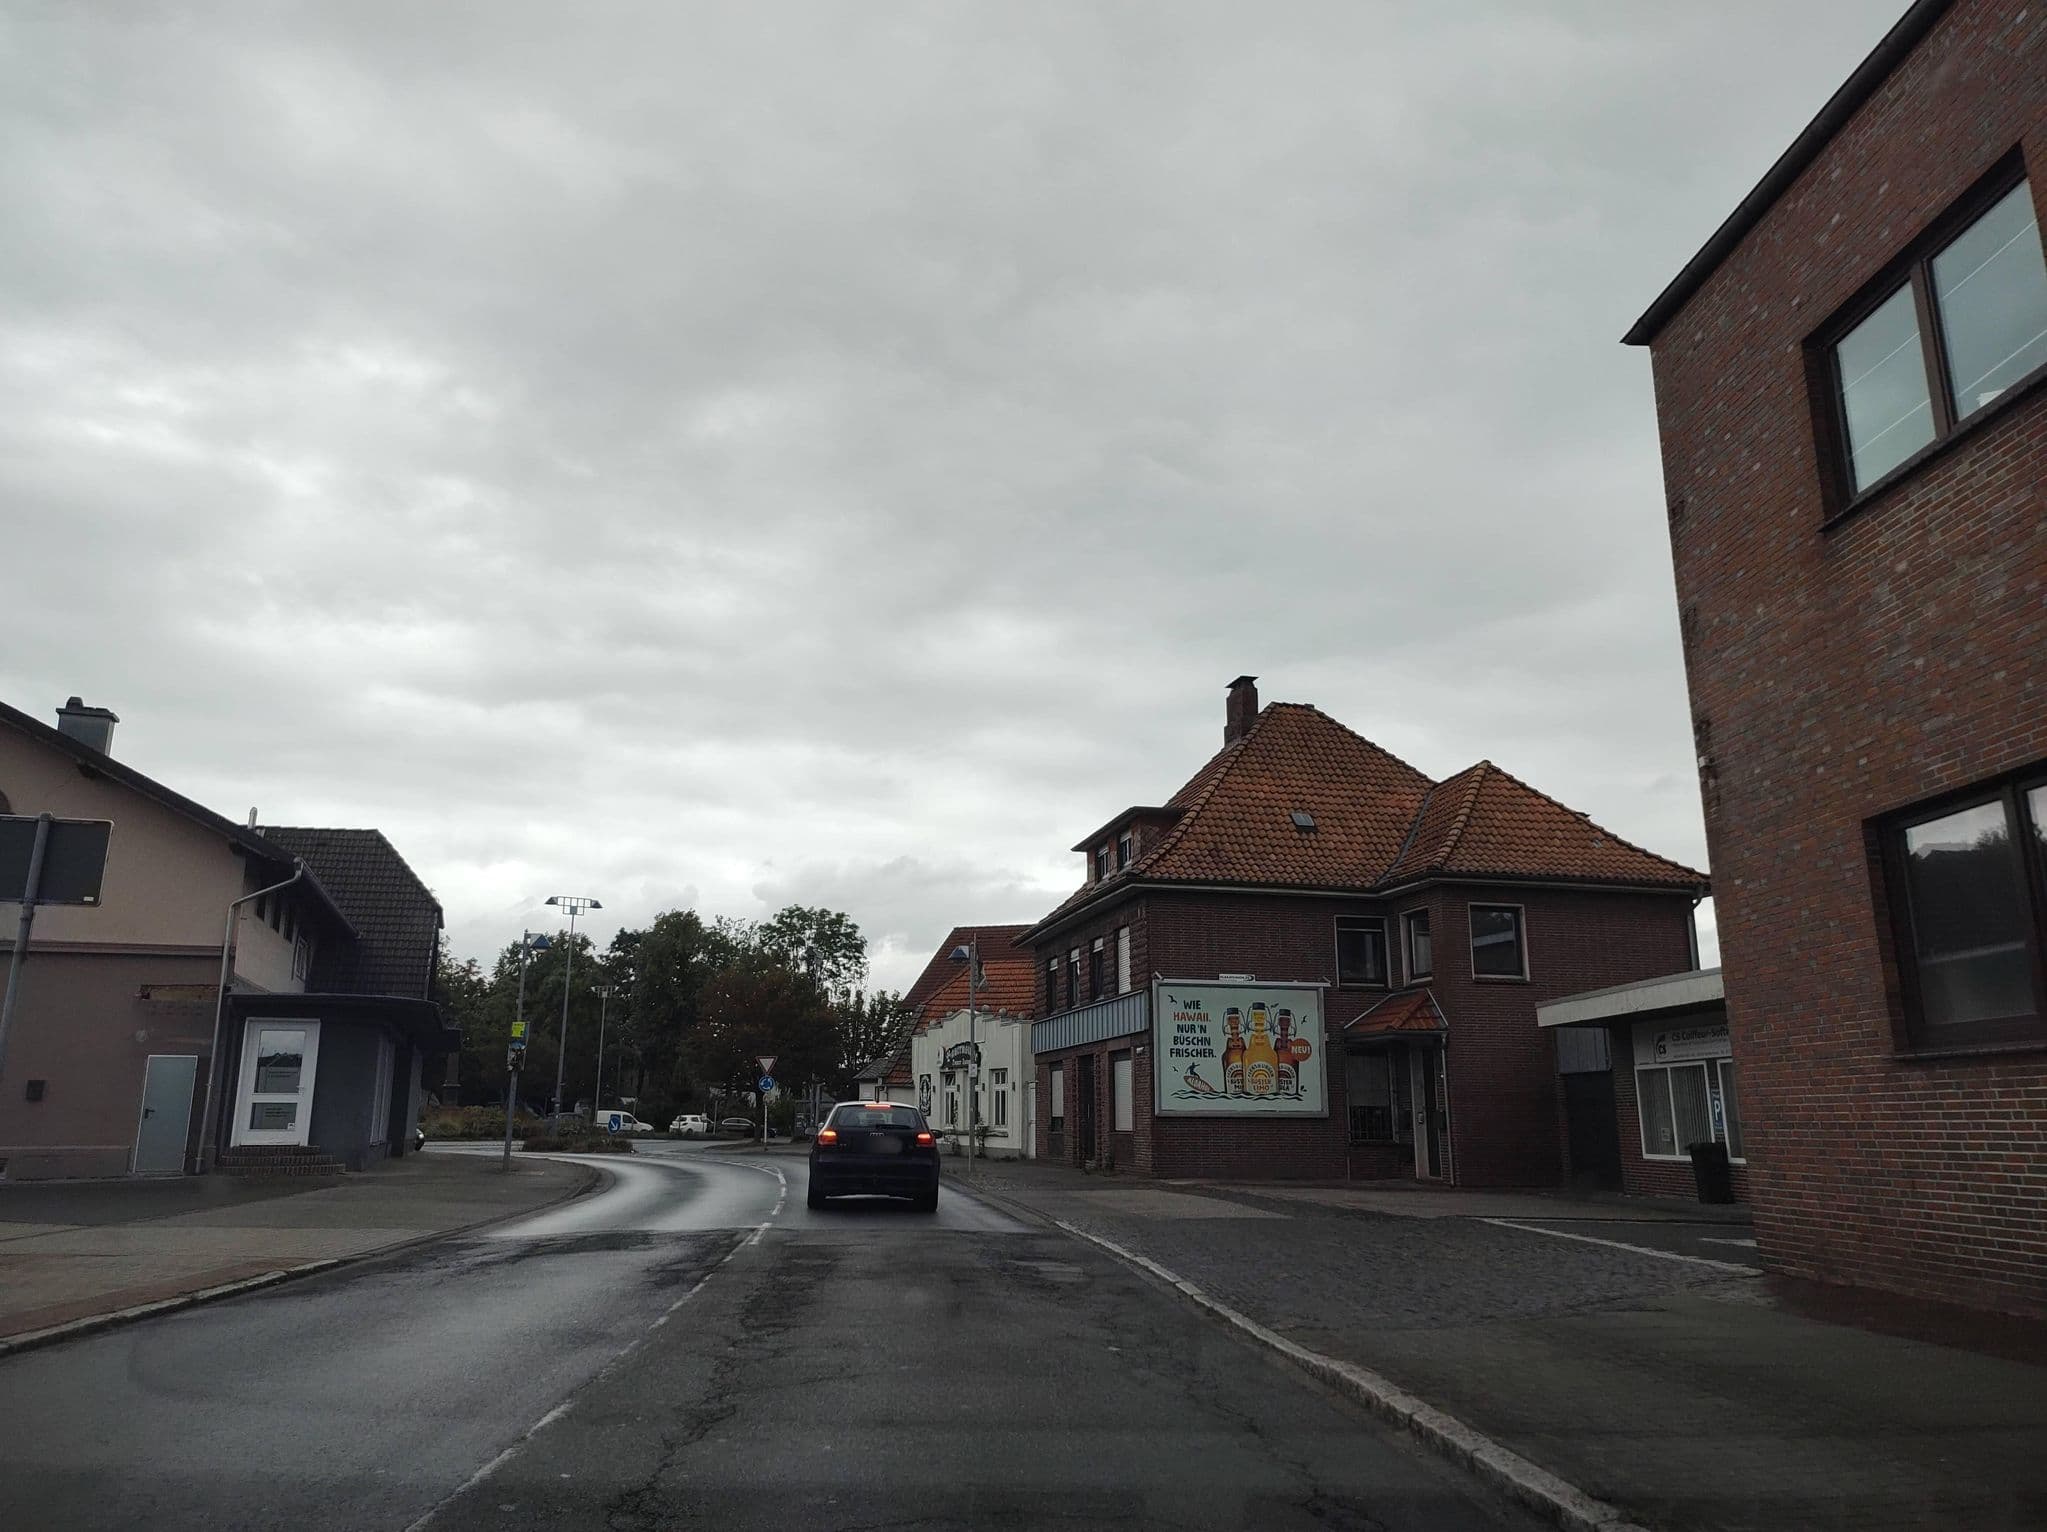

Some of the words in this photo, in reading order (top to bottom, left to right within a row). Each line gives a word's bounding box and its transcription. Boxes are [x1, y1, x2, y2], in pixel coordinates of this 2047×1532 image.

[1183, 999, 1201, 1010] WIE
[1173, 1012, 1211, 1022] HAWAII.
[1169, 1048, 1217, 1058] FRISCHER.
